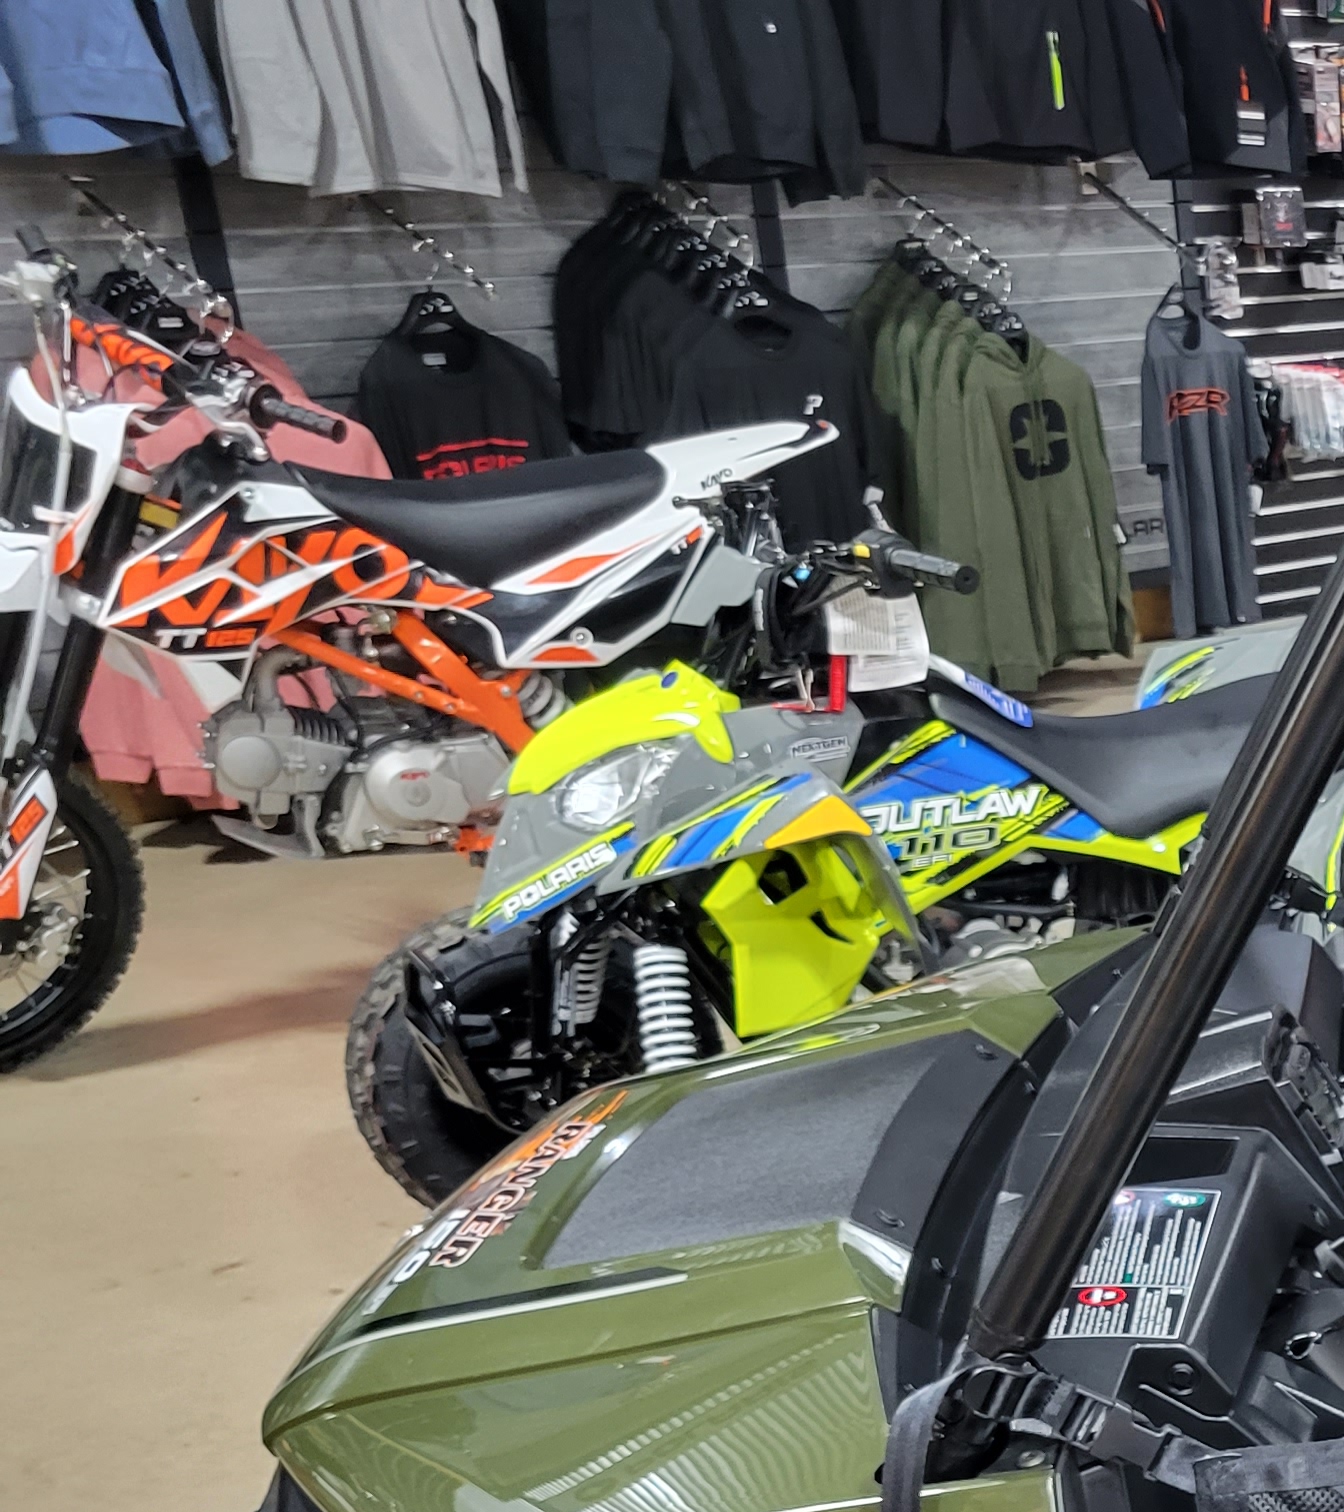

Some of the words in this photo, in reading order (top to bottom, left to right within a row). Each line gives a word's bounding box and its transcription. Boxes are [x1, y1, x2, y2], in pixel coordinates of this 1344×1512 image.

[119, 512, 411, 635] KAYO
[154, 628, 208, 649] TT
[859, 785, 1043, 836] OUTLAW
[902, 823, 1000, 861] 110
[502, 842, 618, 922] POLARIS
[429, 1120, 593, 1268] RANGER
